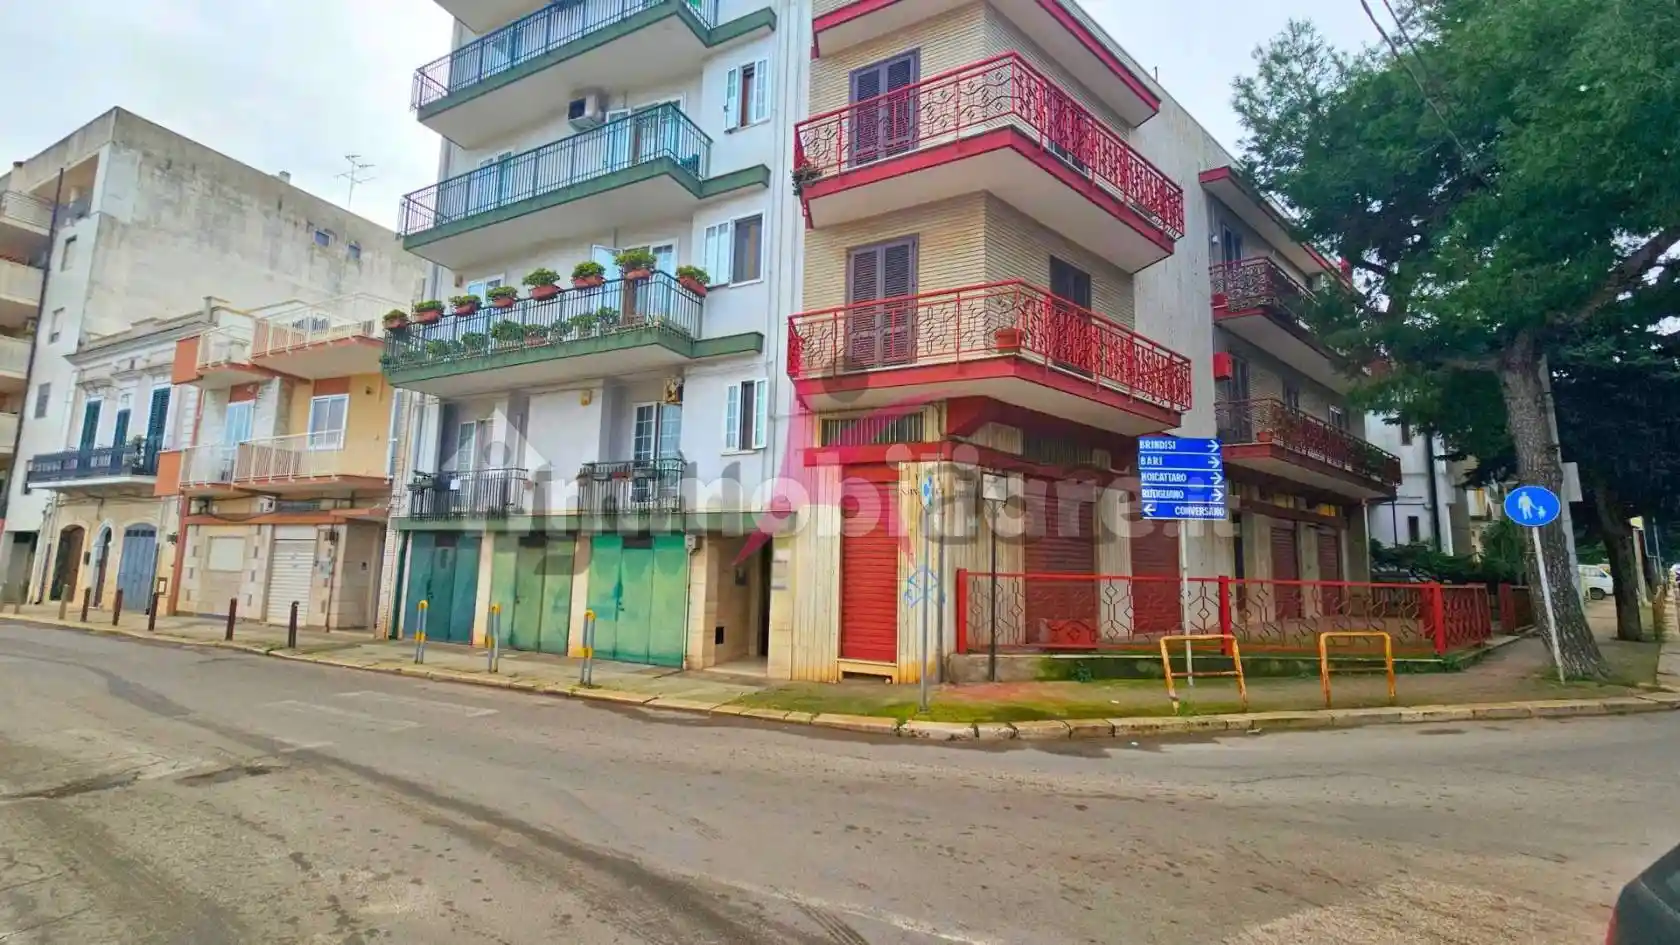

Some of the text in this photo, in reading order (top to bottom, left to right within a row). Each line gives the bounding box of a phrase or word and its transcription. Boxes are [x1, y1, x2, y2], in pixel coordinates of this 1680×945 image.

[1140, 440, 1176, 450] BRINDISI
[1141, 456, 1163, 465] BARI
[1174, 506, 1225, 516] CONVERSANO
